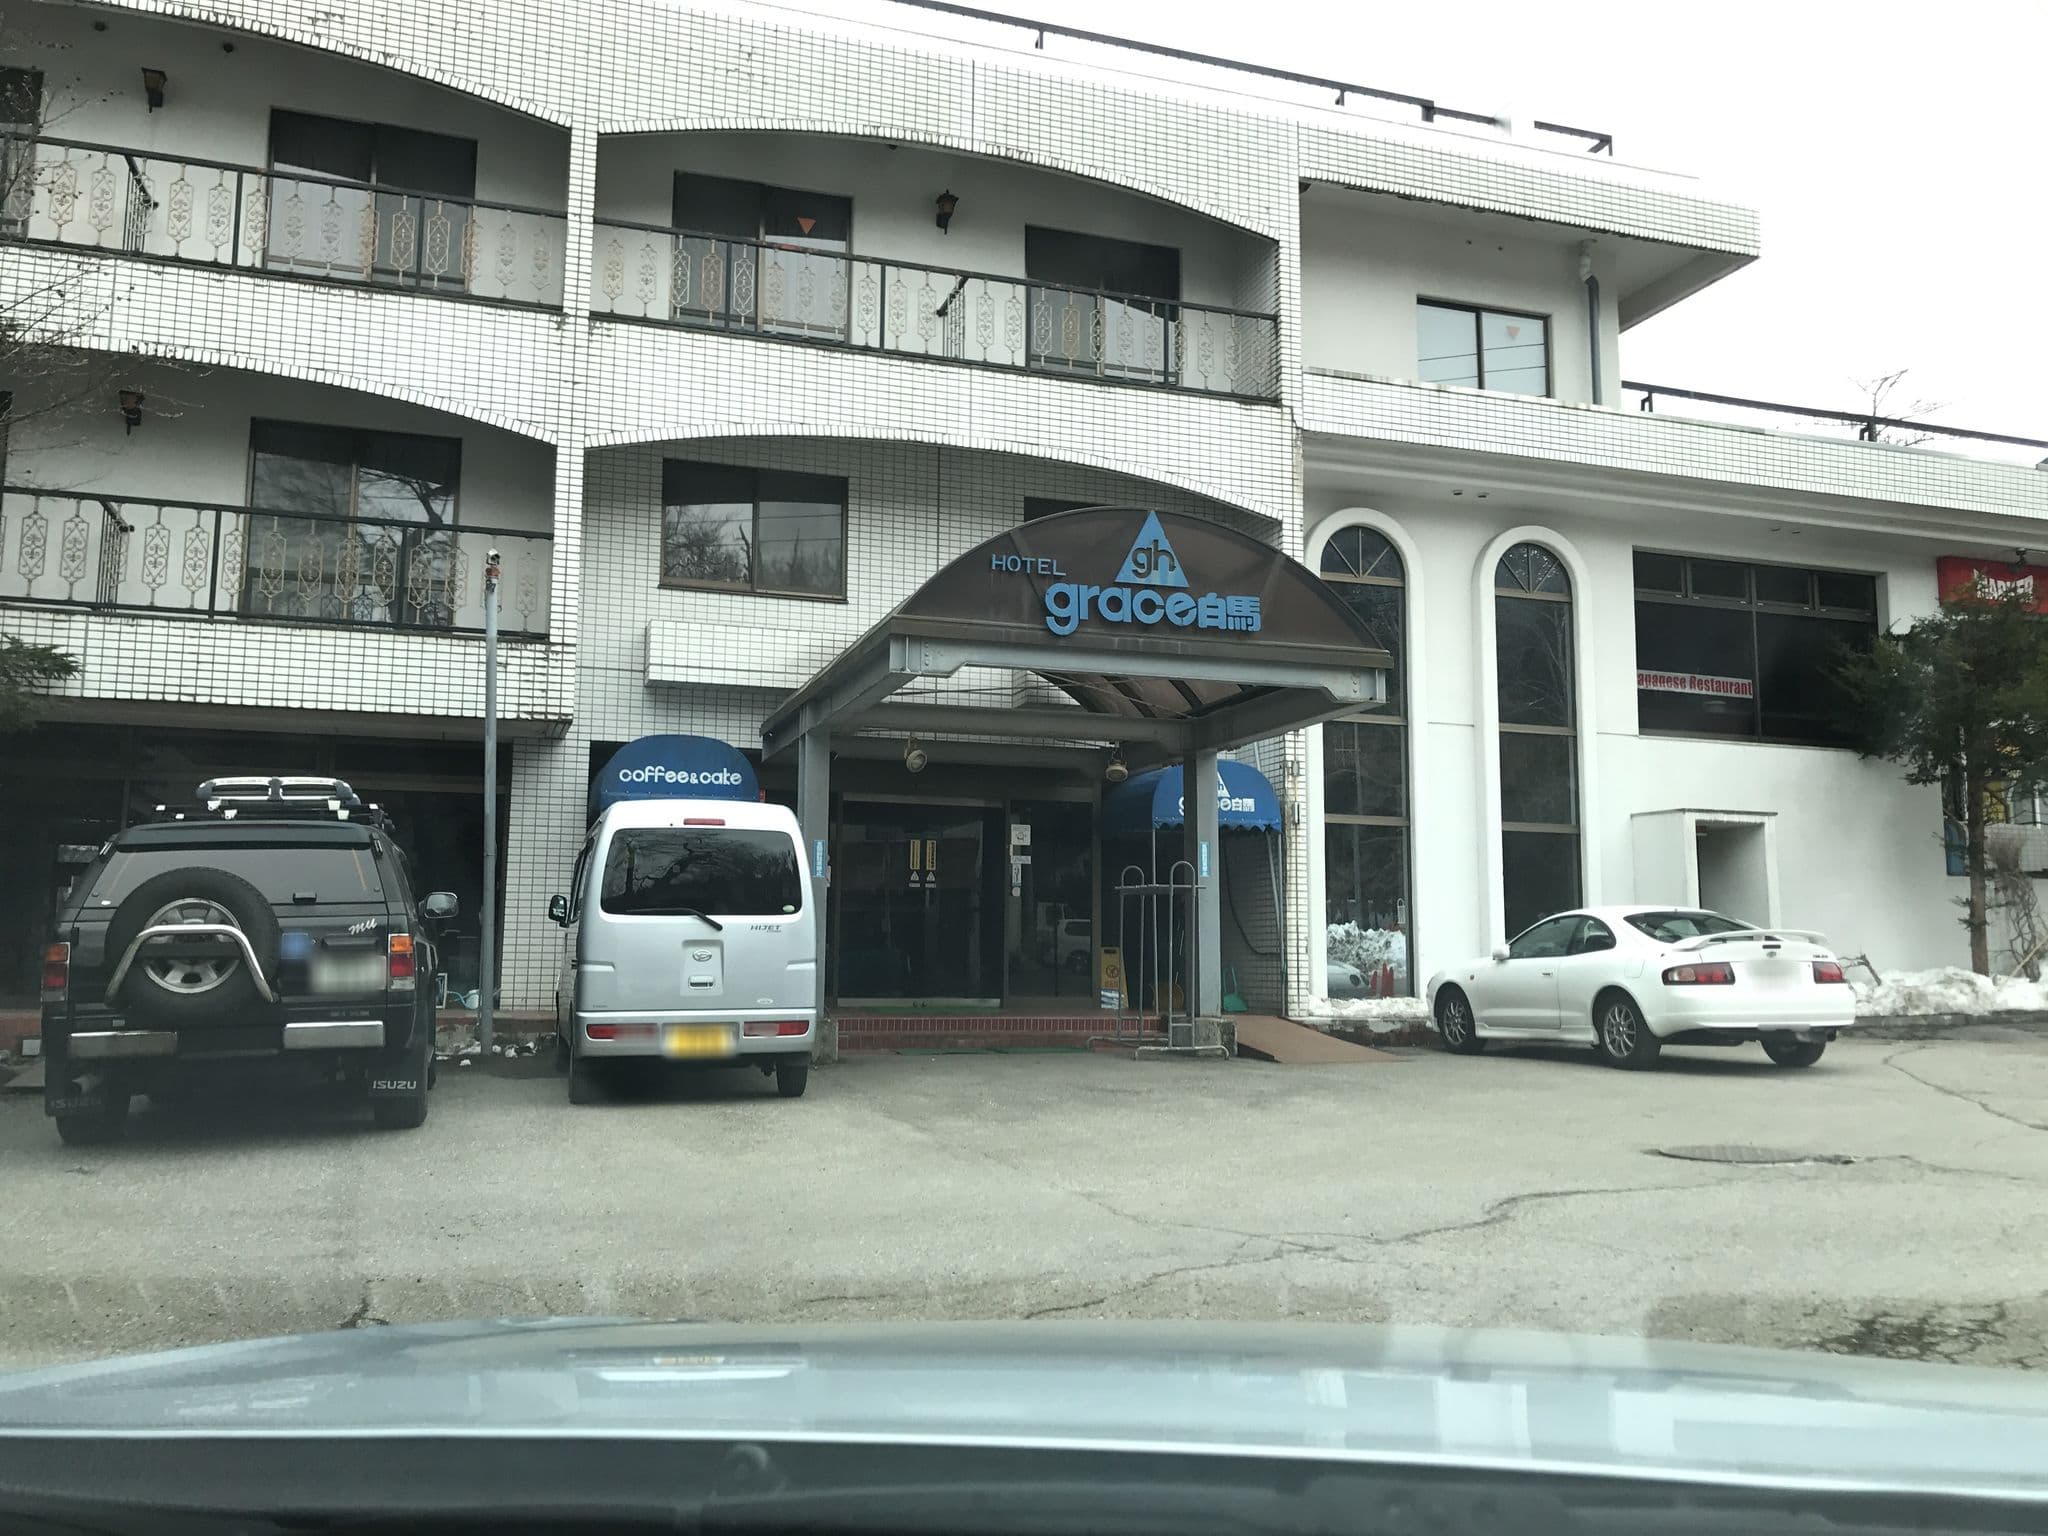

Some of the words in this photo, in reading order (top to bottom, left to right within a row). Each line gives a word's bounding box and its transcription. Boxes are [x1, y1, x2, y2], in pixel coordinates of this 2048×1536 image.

[991, 553, 1067, 576] HOTEL
[1132, 539, 1176, 579] gh
[1637, 672, 1687, 690] apanese
[1689, 675, 1753, 696] Restaurant
[372, 1080, 417, 1090] ISUZU
